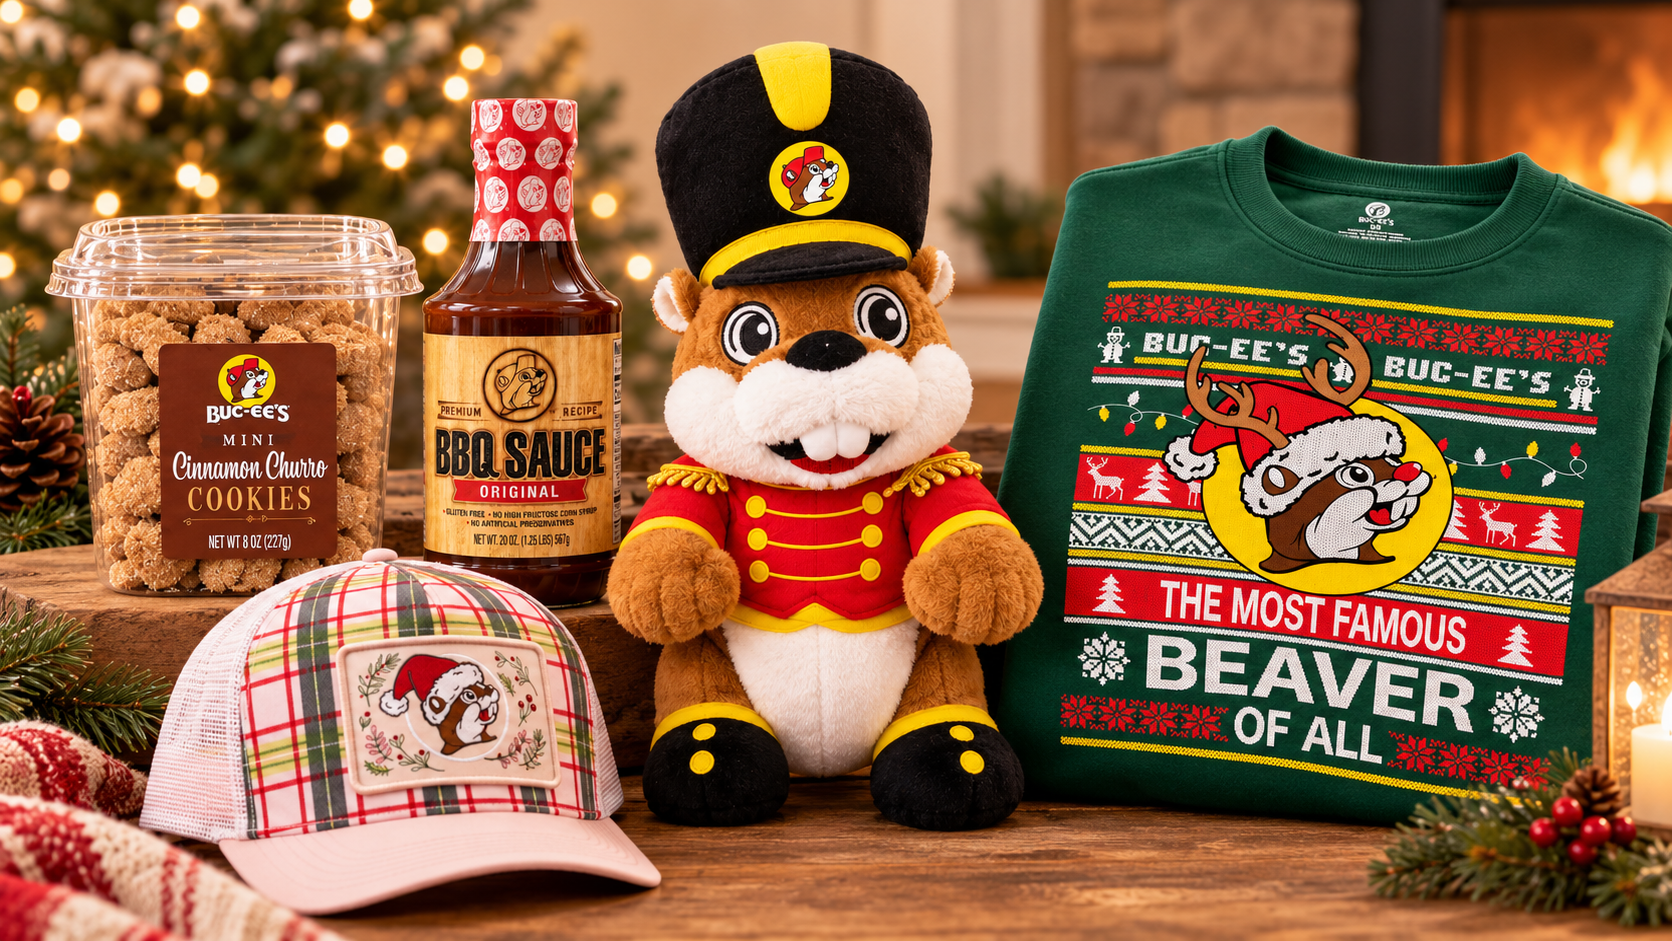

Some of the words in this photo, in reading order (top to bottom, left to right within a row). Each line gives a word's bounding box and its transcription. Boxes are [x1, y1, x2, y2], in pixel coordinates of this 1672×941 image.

[1384, 355, 1552, 394] BUC-EE'S
[206, 404, 290, 424] BUC-EE'S
[440, 405, 482, 417] PREMIUM
[563, 405, 598, 417] RECIPE
[223, 434, 274, 446] MINI
[172, 451, 263, 481] Cinnamon
[265, 450, 328, 480] Churro
[435, 429, 500, 479] BBQ
[505, 429, 605, 479] SAUCE
[187, 485, 311, 512] COOKIES
[480, 485, 559, 498] ORIGINAL
[469, 510, 485, 518] FREE
[208, 534, 225, 549] NET
[226, 534, 241, 549] WT
[242, 534, 249, 549] 8
[250, 534, 262, 549] OZ
[263, 533, 292, 551] (227g)
[473, 533, 486, 545] NET
[486, 533, 498, 545] WT.
[499, 534, 508, 546] 20
[508, 534, 519, 546] OZ.
[538, 534, 553, 547] LBS)
[1160, 580, 1223, 622] THE
[1231, 587, 1326, 634] MOST
[1333, 599, 1466, 654] FAMOUS
[1145, 634, 1475, 733] BEAVER
[1234, 706, 1291, 747] OF
[1301, 716, 1383, 764] ALL
